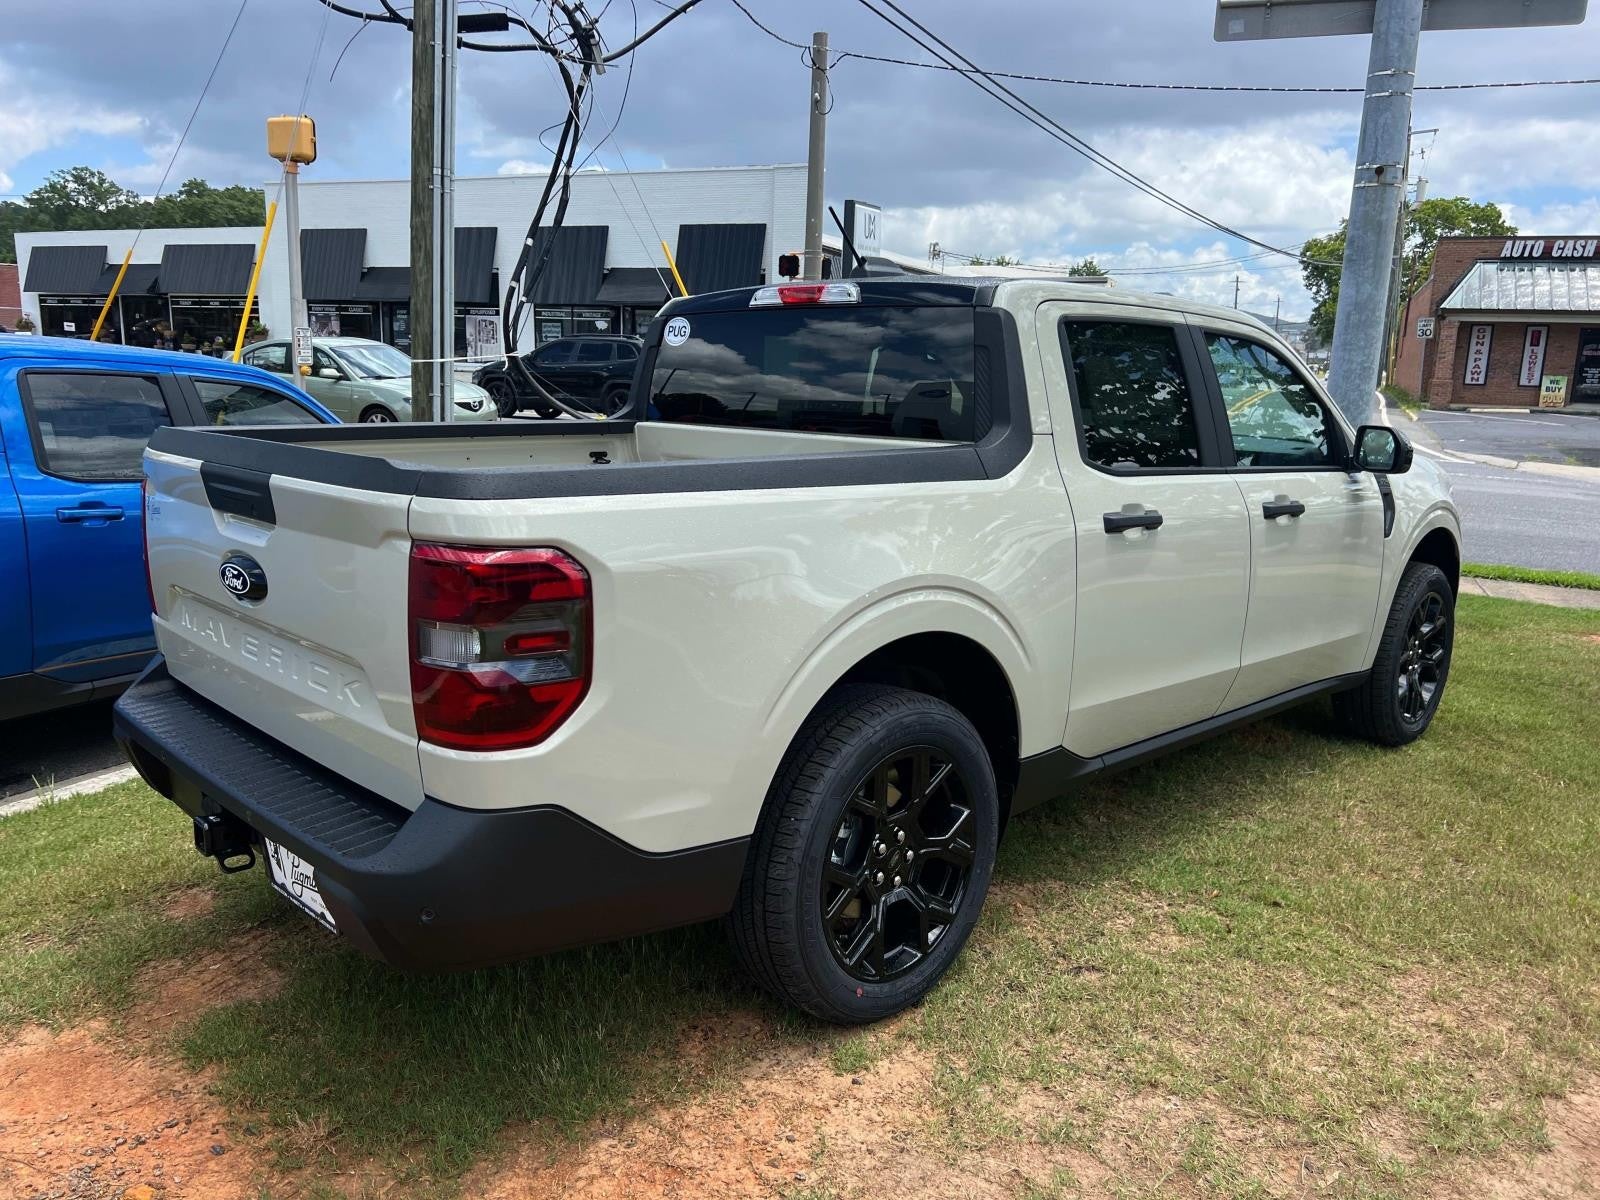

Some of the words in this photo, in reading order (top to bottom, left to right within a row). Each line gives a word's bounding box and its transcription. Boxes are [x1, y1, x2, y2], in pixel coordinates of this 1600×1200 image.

[1500, 240, 1545, 257] AUTO
[1551, 240, 1598, 257] CASH
[668, 326, 687, 338] PUG
[1418, 328, 1432, 337] 30
[1475, 327, 1487, 347] GUN
[1470, 357, 1482, 382] PAWN
[1526, 348, 1538, 384] LOWEST
[224, 566, 244, 590] Ford
[182, 605, 361, 708] MAVERICK
